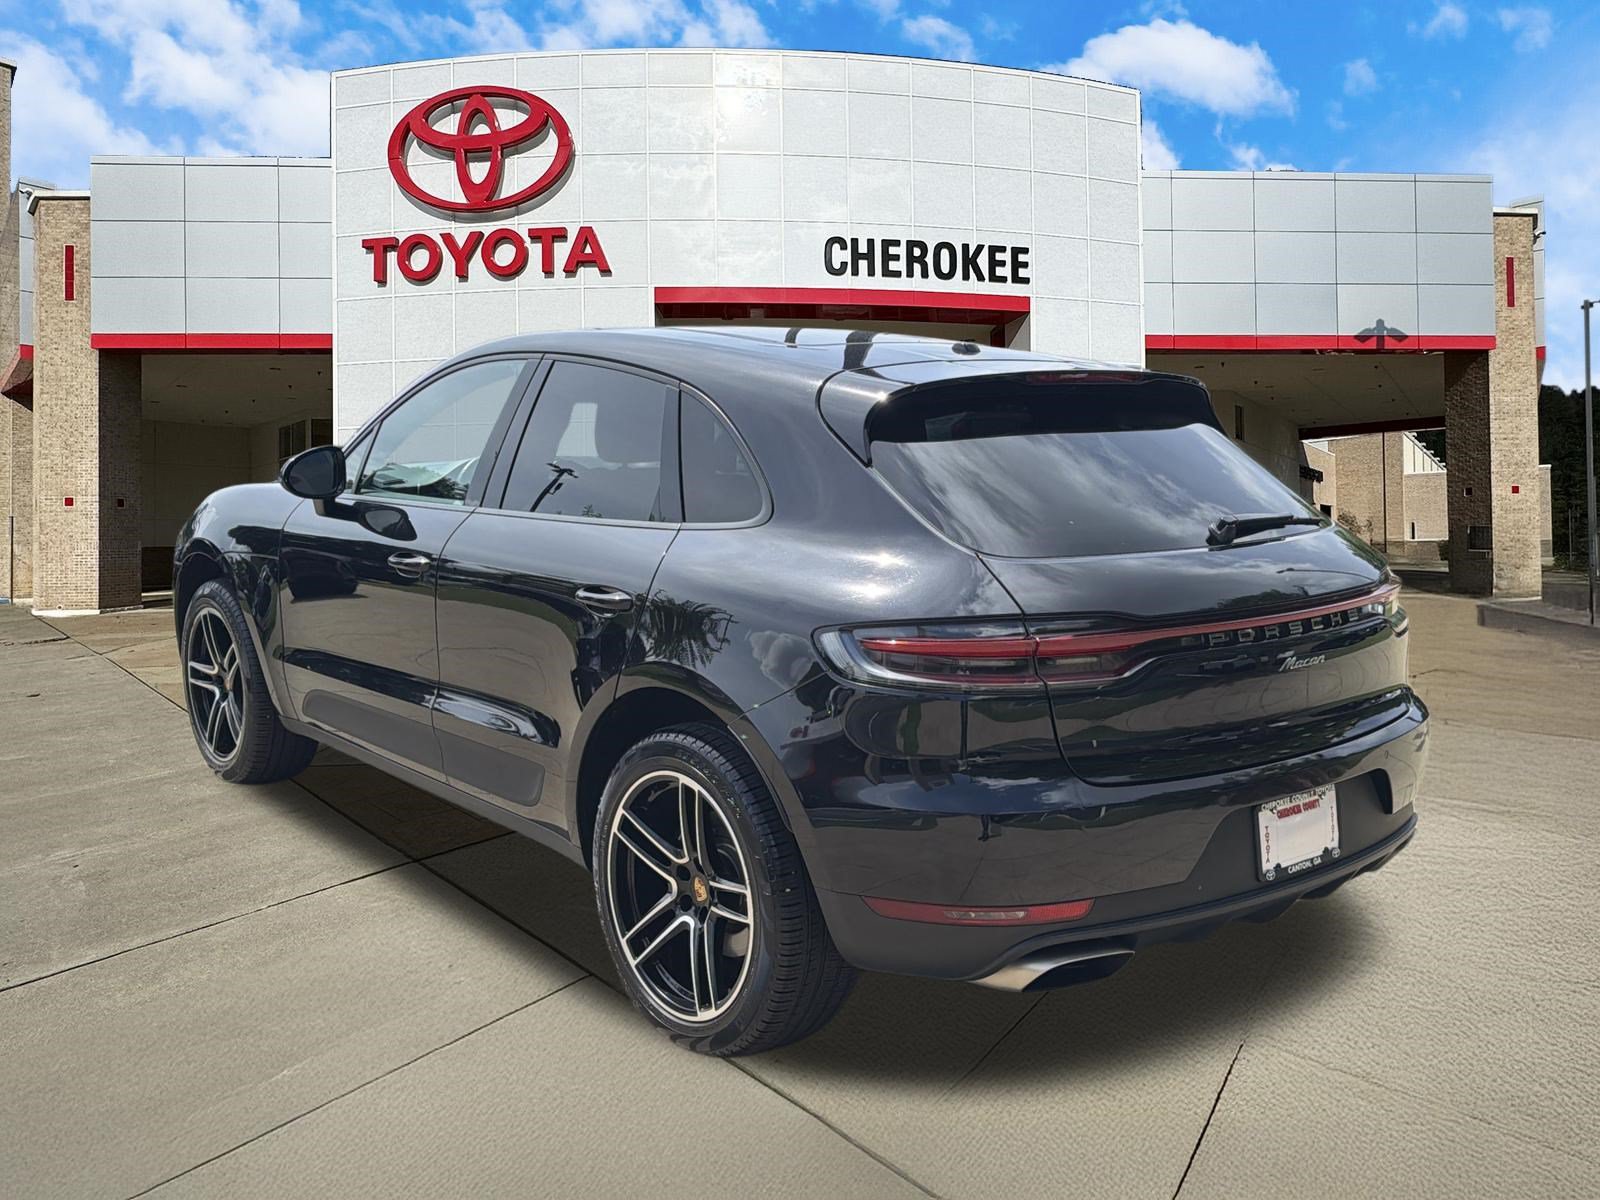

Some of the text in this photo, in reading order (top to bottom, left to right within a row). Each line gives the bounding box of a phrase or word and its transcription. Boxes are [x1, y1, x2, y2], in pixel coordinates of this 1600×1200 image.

[362, 226, 611, 285] TOYOTA
[825, 236, 1031, 284] CHEROKEE
[1207, 609, 1360, 647] PORSCHE
[1279, 655, 1326, 672] Macan
[1303, 799, 1321, 812] COUNTY
[1313, 857, 1322, 866] GA
